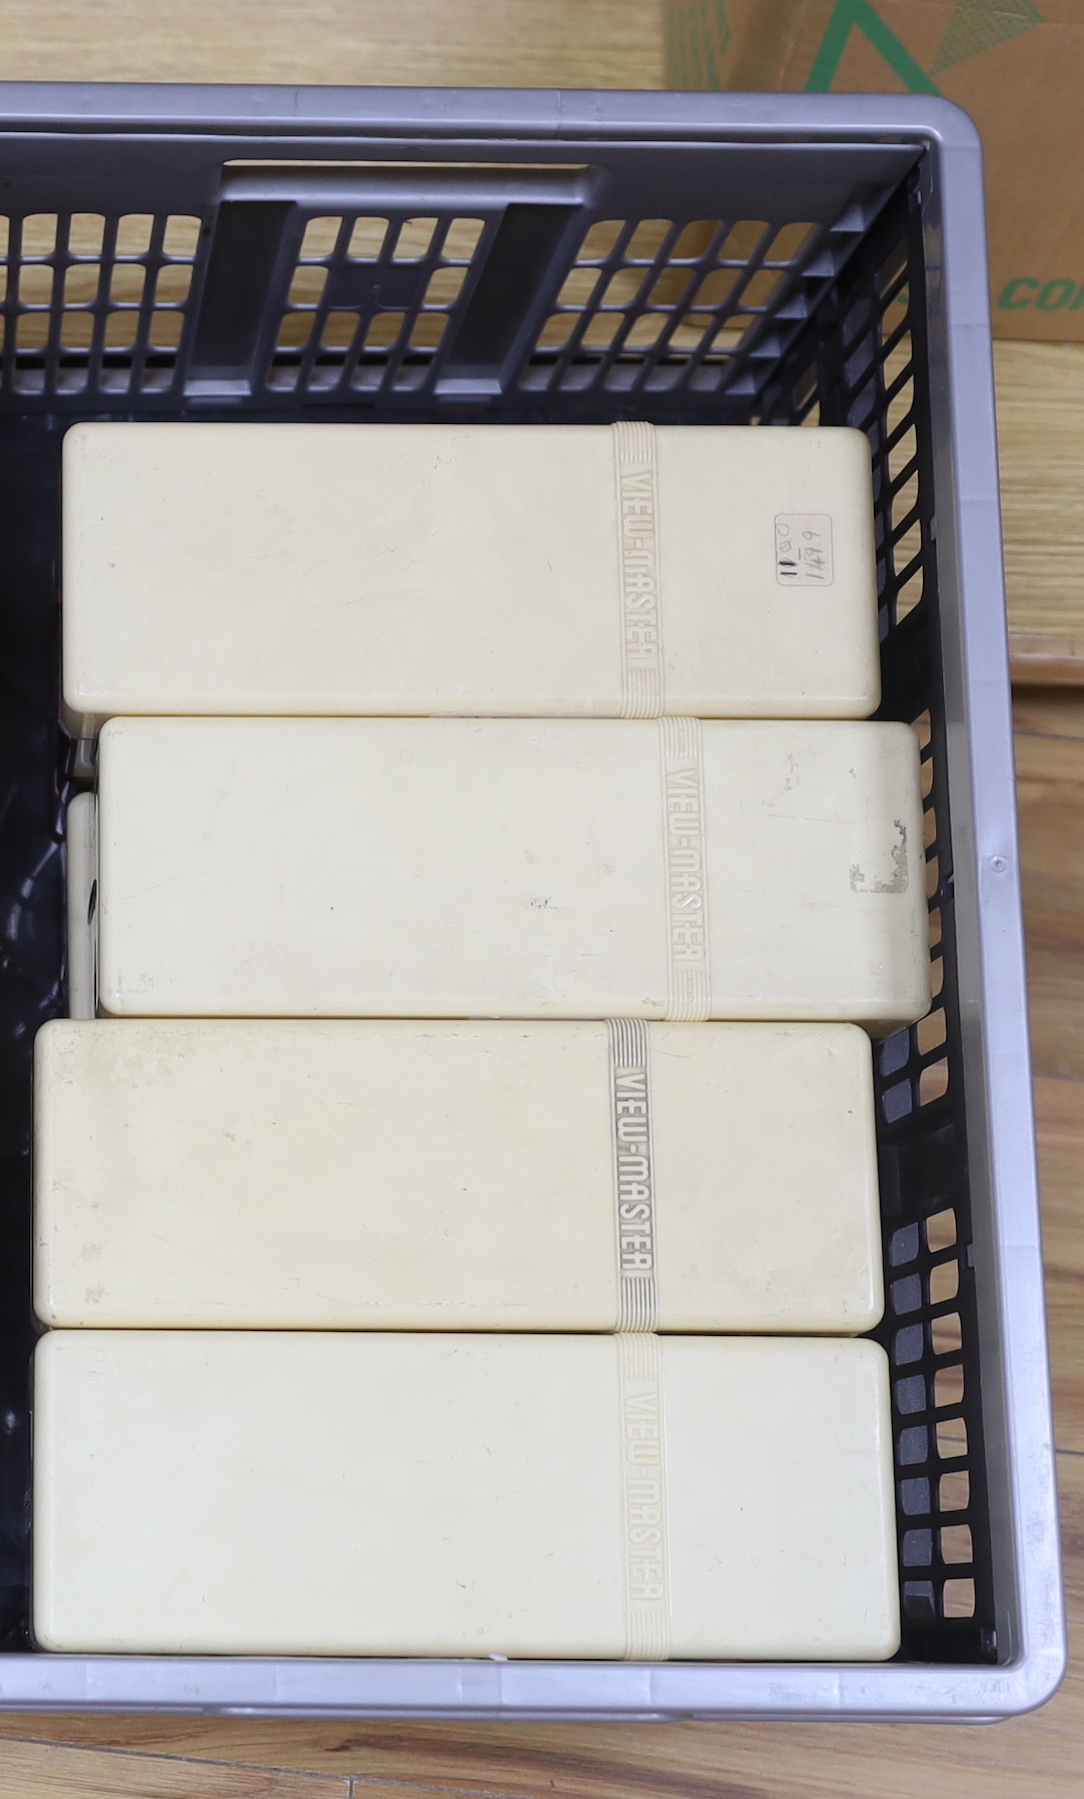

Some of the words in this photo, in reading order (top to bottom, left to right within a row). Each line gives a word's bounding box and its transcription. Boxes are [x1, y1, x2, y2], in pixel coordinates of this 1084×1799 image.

[620, 470, 659, 657] VIEW-MASTER
[667, 767, 705, 962] VIEW-MASTER
[615, 1072, 653, 1270] VIEW-MASTER
[624, 1391, 664, 1601] VIEW-MASTER
